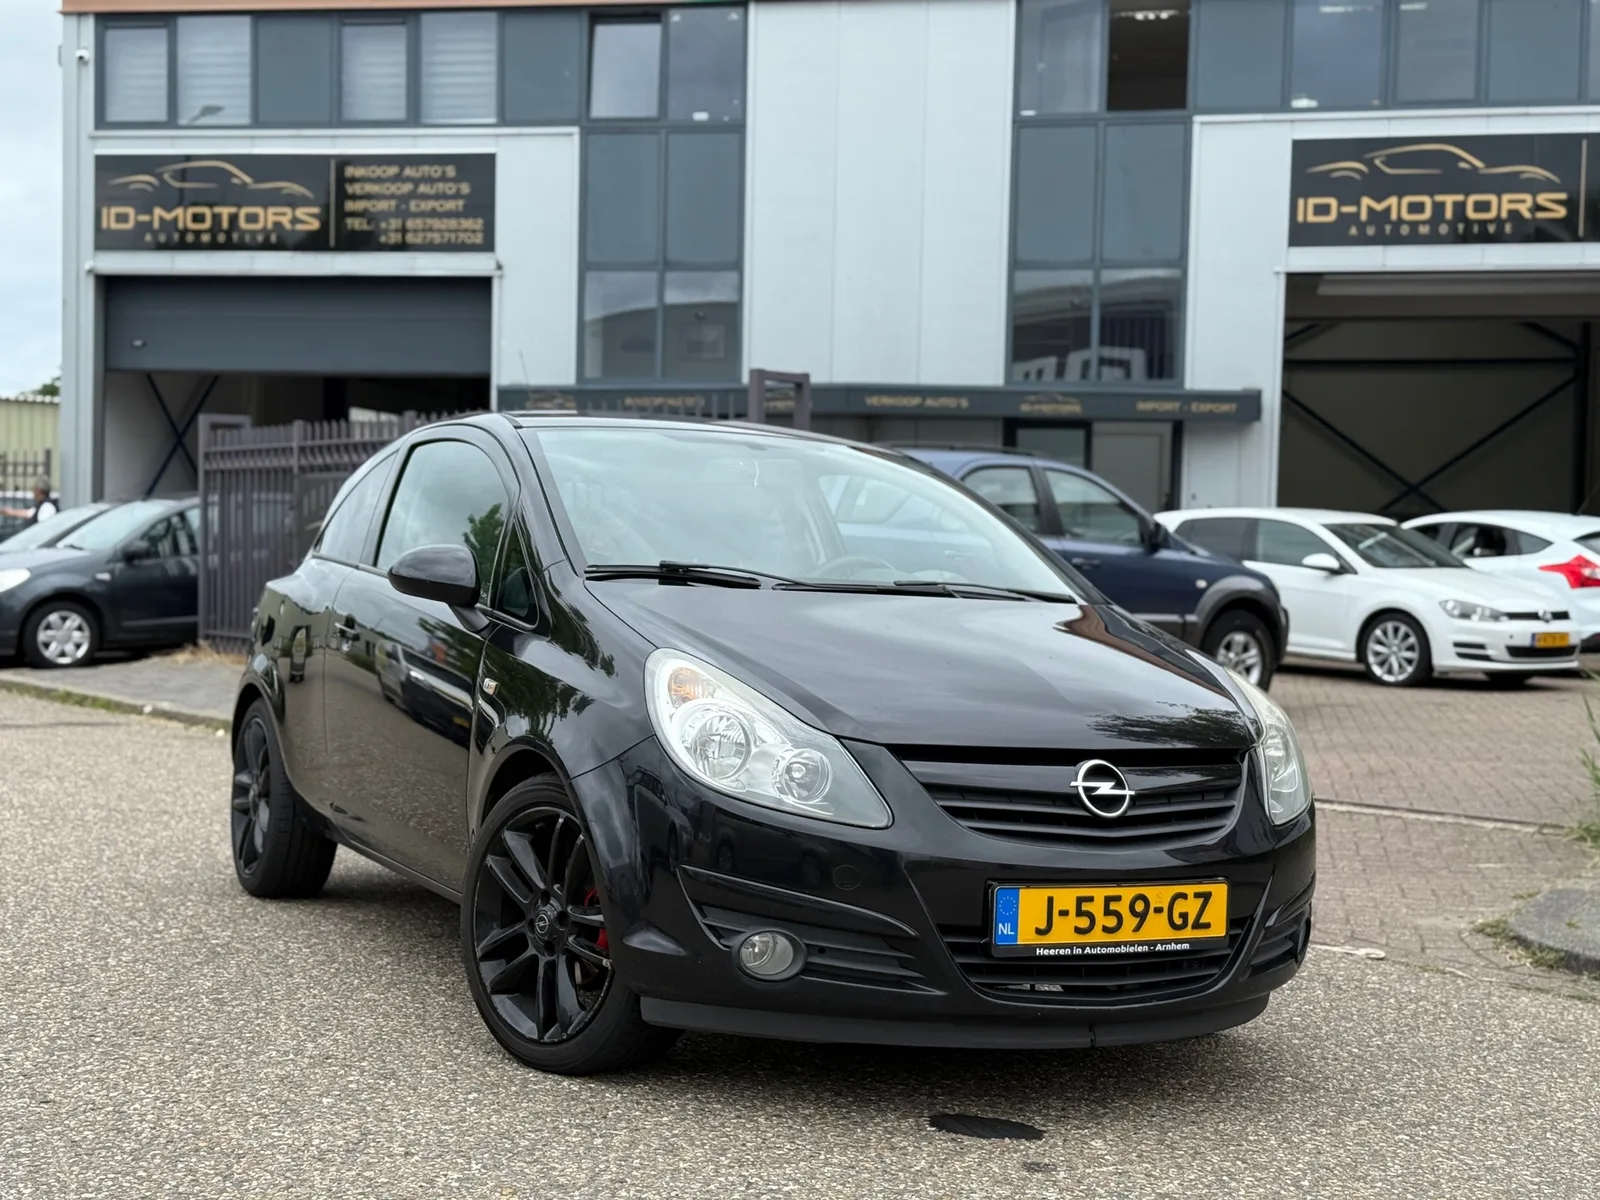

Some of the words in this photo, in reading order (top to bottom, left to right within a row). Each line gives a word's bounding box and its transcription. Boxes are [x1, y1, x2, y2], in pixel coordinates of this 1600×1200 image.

[344, 165, 400, 178] INKOOP
[402, 165, 457, 178] AUTO'S
[344, 182, 415, 195] VERKOOP
[416, 182, 471, 195] AUTO'S
[344, 199, 398, 212] IMPORT
[409, 199, 466, 212] EXPORT
[1296, 192, 1568, 223] ID-MOTORS
[101, 206, 321, 231] ID-MOTORS
[1348, 222, 1514, 237] AUTOMOTIVE
[144, 232, 278, 244] AUTOMOTIVE
[1034, 891, 1213, 936] J-559-GZ
[998, 923, 1014, 935] NL
[1036, 947, 1071, 956] Heeren
[1073, 946, 1082, 955] in
[1084, 944, 1149, 955] Automobielen
[1155, 942, 1190, 952] Arnhem
